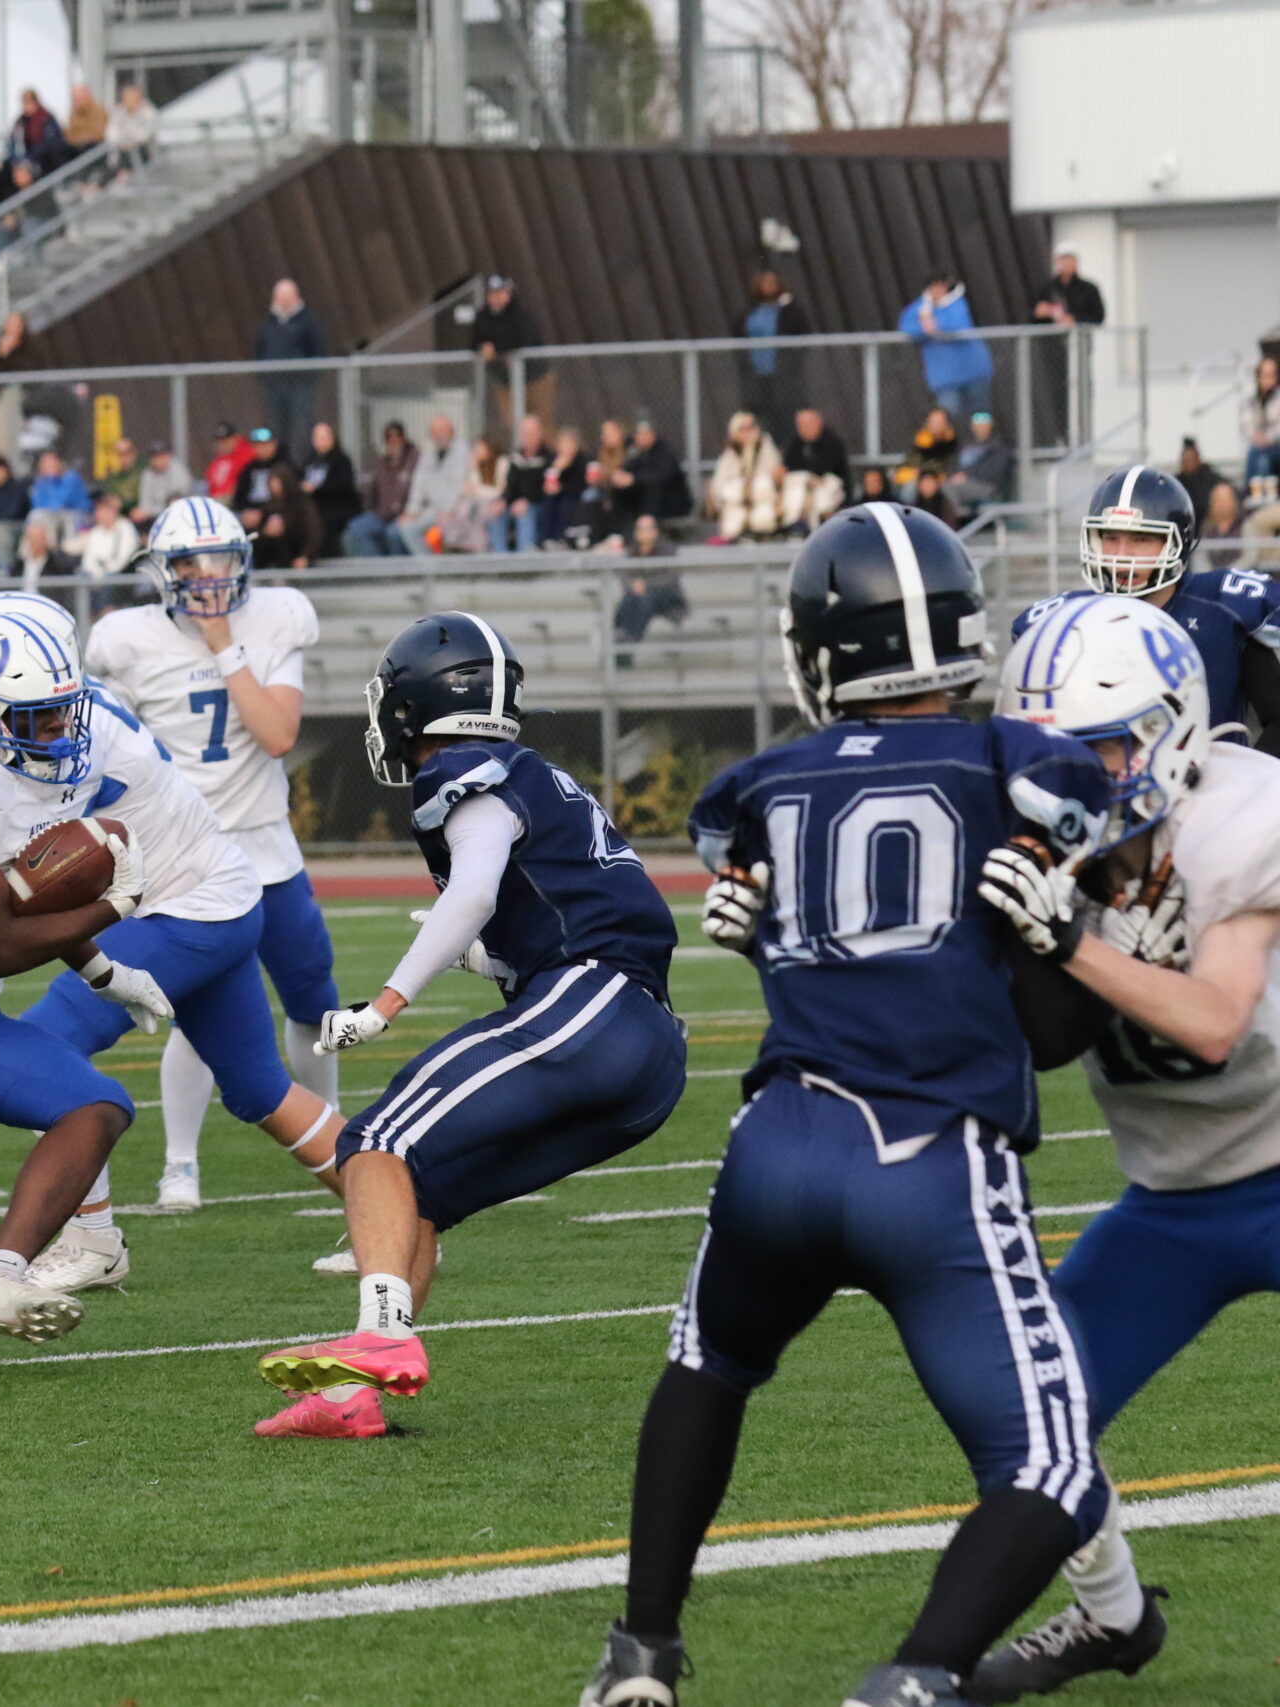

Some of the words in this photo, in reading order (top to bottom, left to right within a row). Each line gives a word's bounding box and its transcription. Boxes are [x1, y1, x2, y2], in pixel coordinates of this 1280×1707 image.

[189, 689, 230, 763] 7
[763, 783, 966, 974] 10
[986, 1183, 1066, 1386] XAVIER
